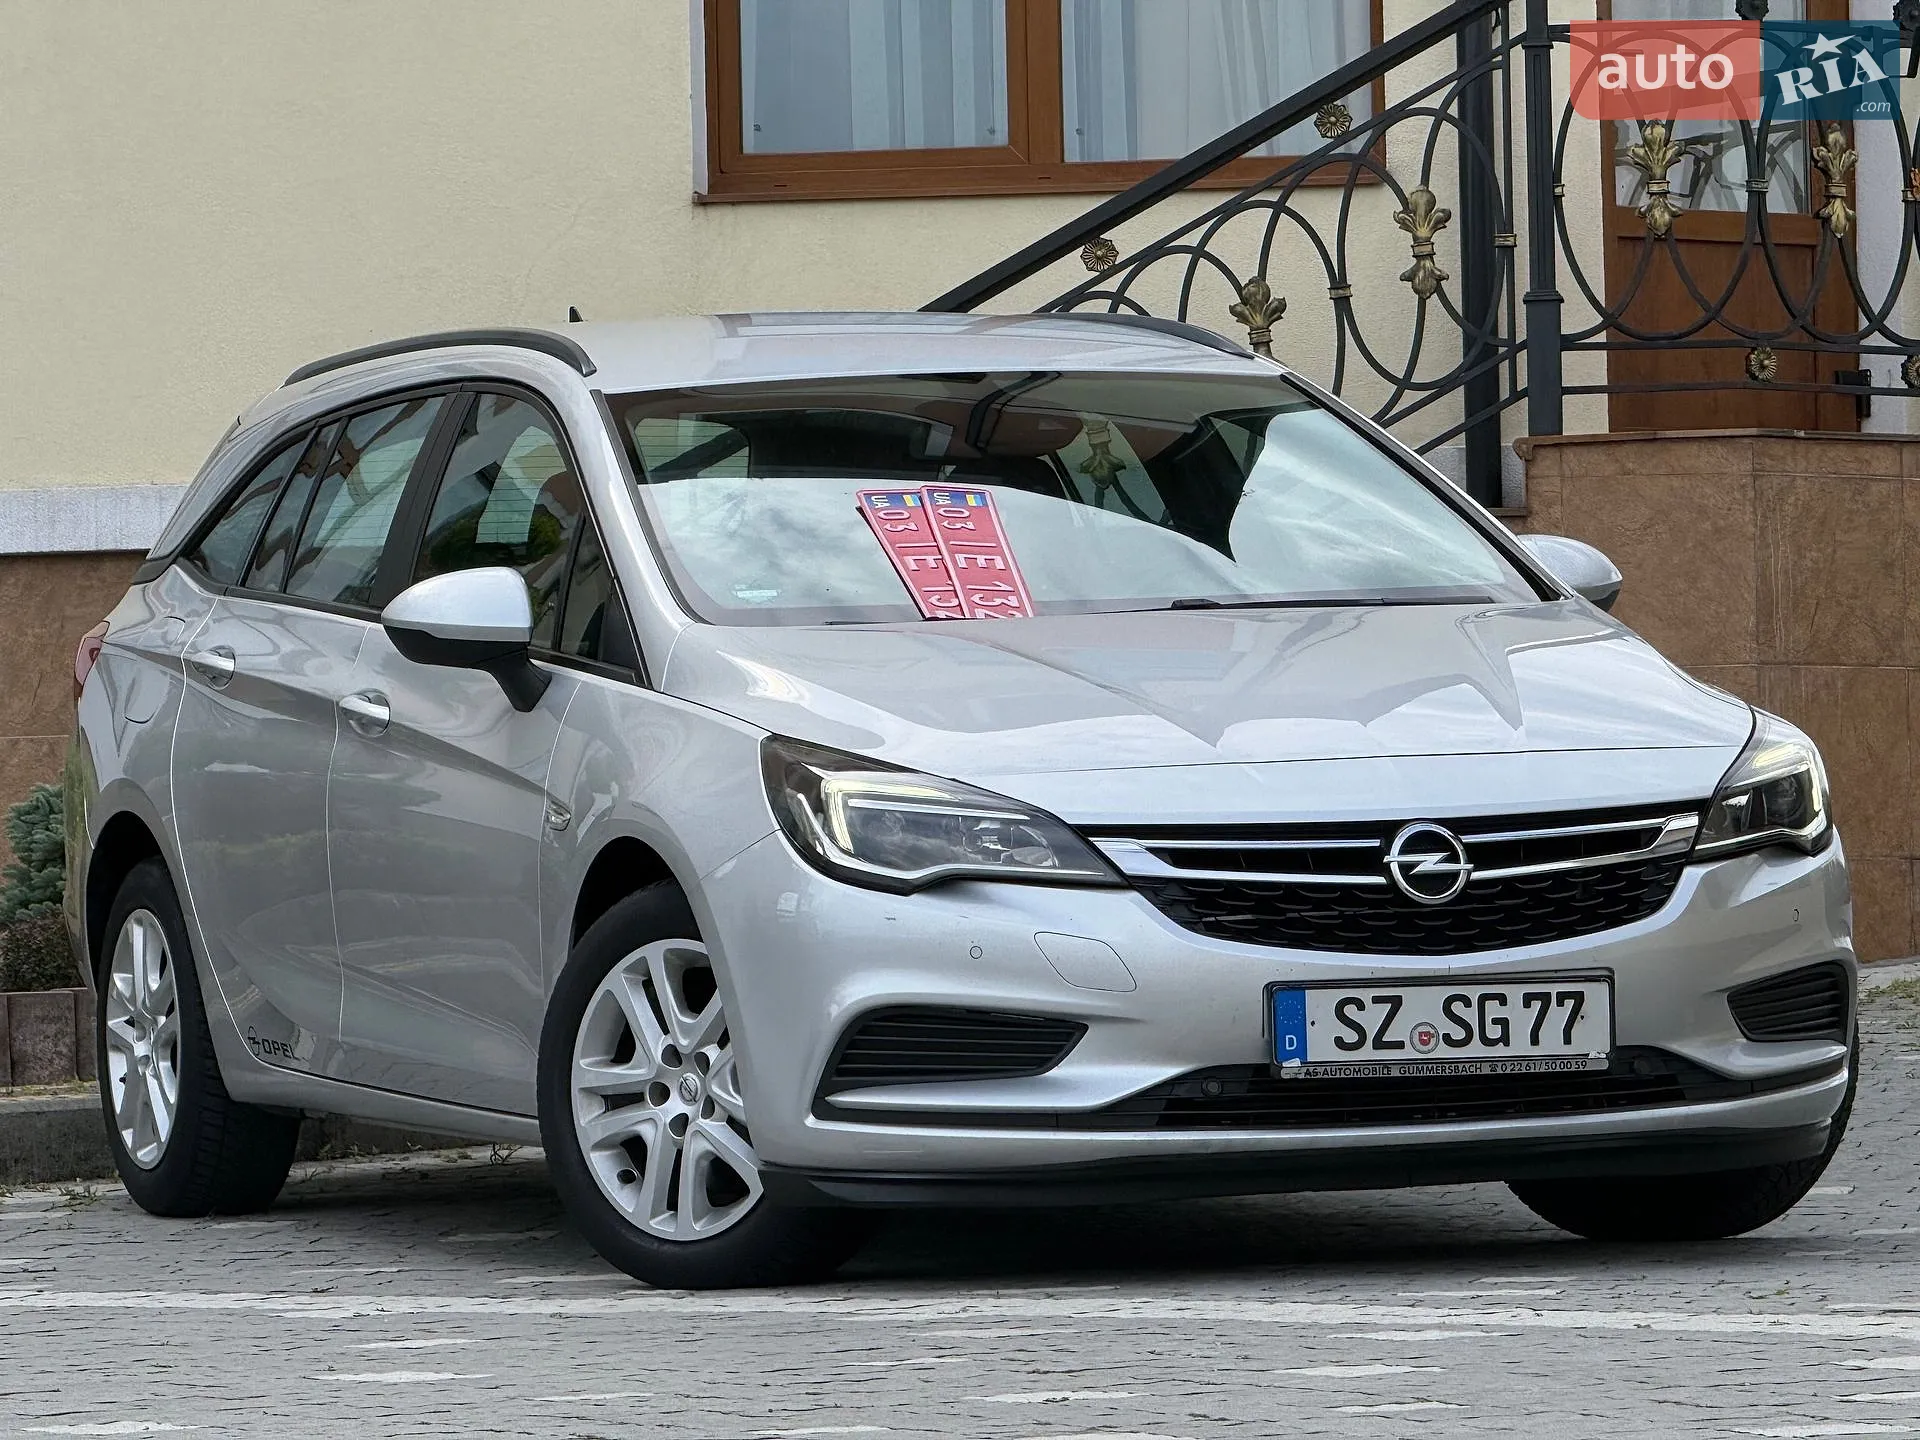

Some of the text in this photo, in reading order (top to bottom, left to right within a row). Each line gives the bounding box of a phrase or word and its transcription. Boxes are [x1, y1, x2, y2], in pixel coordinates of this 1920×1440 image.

[871, 495, 891, 509] UA
[933, 492, 950, 506] UA
[1333, 994, 1405, 1052] SZ
[262, 1038, 300, 1061] OPEL
[1285, 1035, 1297, 1050] D
[1399, 1063, 1482, 1076] GUMMERSBACH
